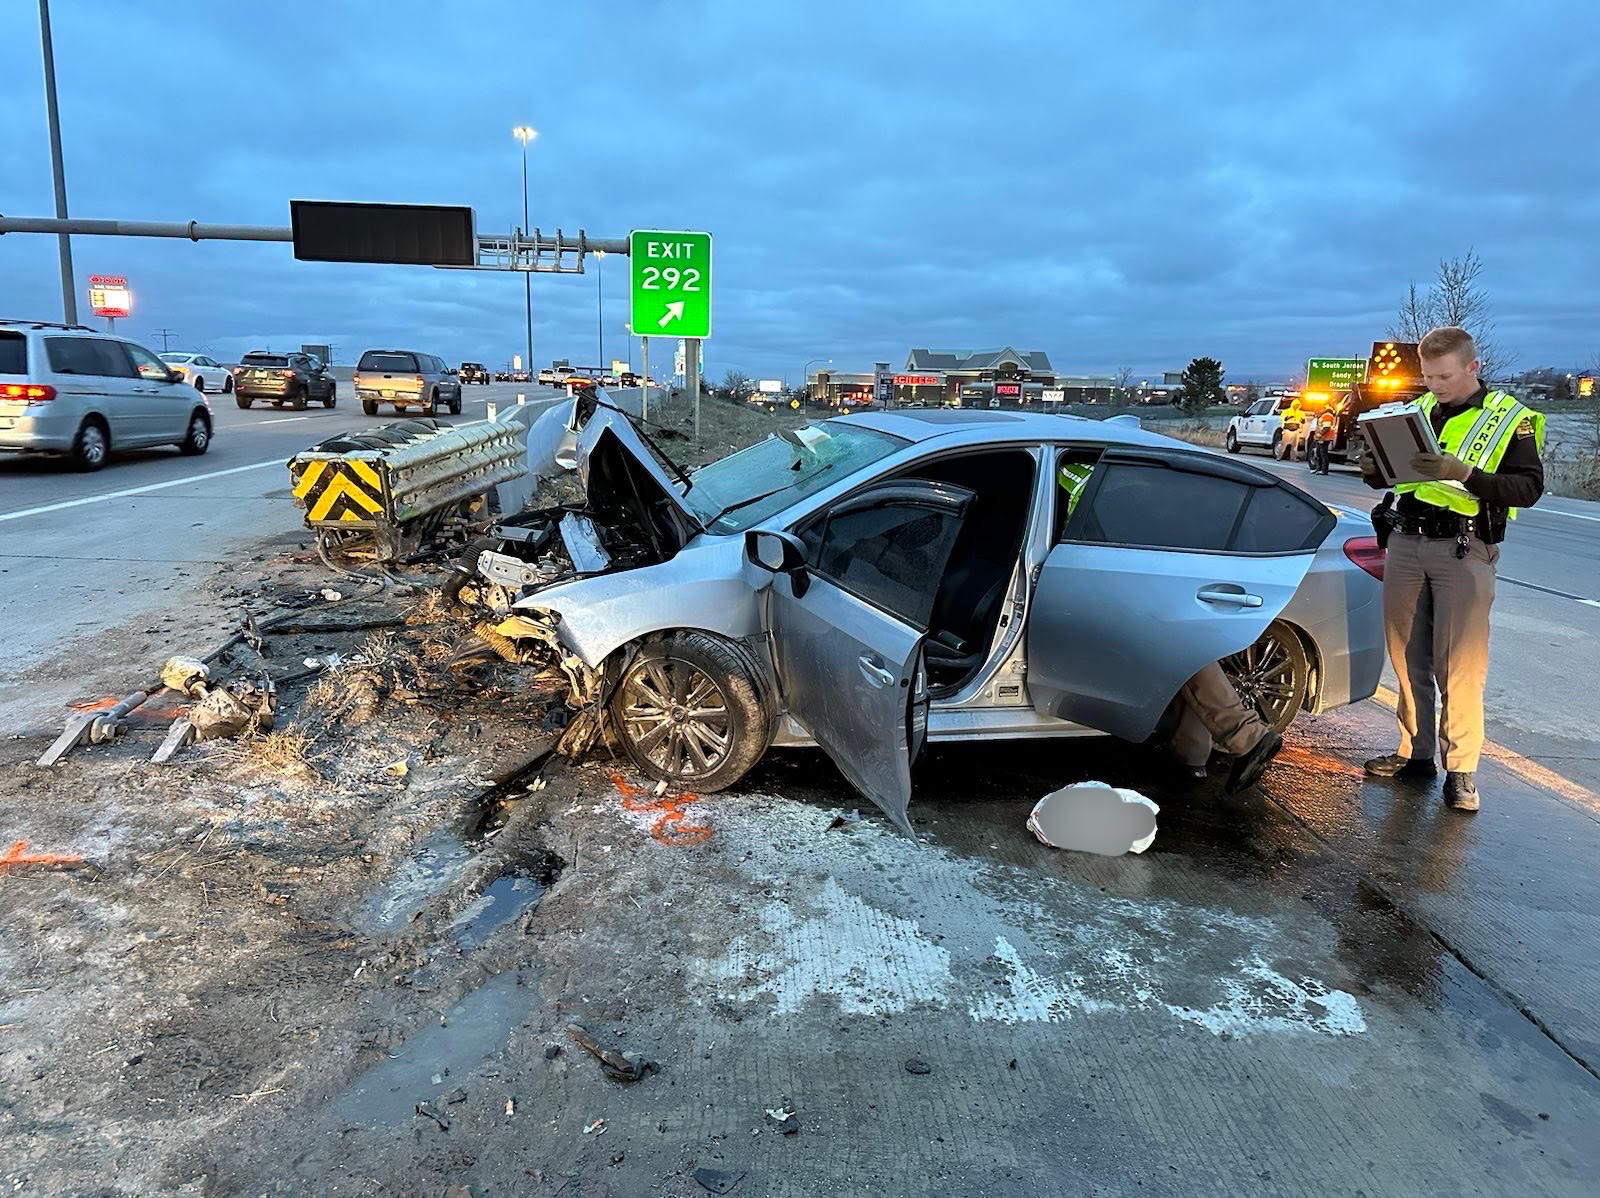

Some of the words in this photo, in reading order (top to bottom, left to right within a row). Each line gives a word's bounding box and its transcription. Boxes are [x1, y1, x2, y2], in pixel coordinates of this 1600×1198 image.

[647, 241, 694, 259] EXIT
[641, 266, 701, 292] 292
[893, 376, 938, 385] SCHEELS
[1329, 381, 1350, 389] Draper
[1467, 406, 1508, 463] PATROL
